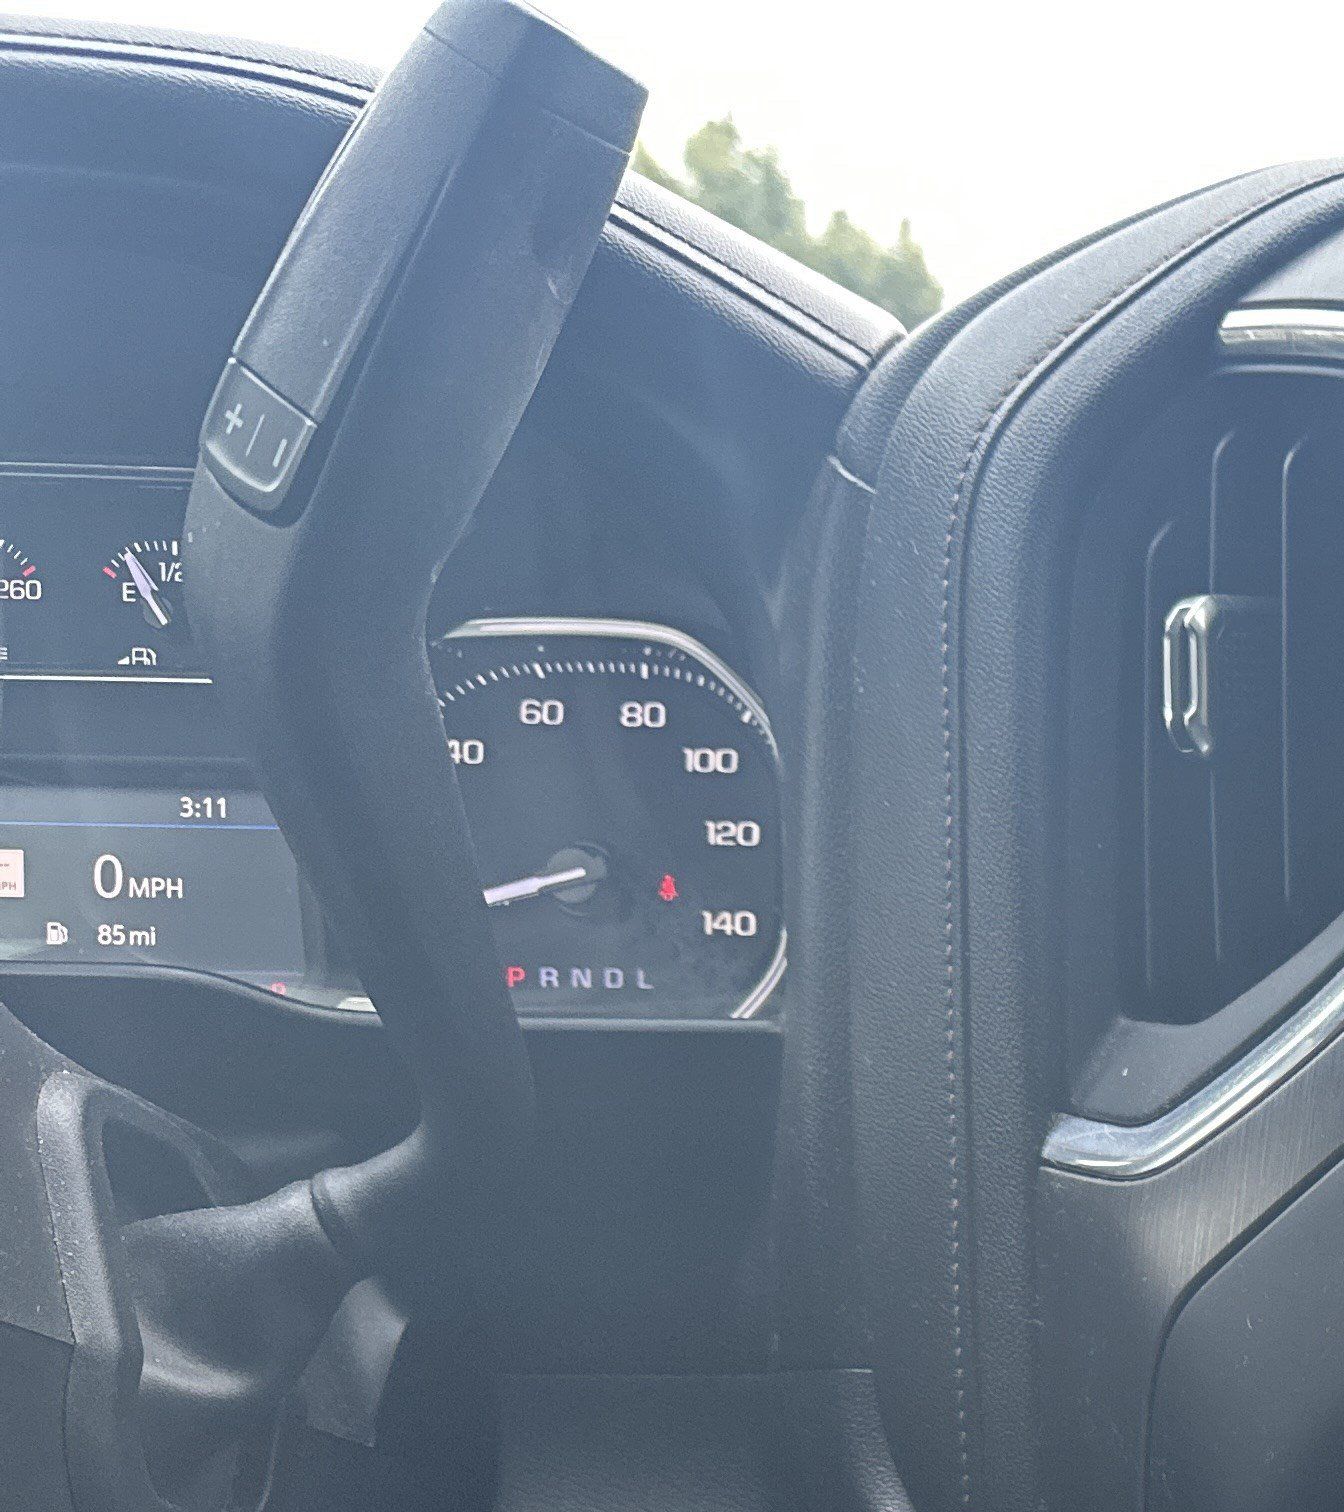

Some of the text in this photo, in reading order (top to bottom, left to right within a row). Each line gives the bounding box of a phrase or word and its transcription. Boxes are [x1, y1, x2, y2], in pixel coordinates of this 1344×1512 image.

[0, 579, 43, 601] 260
[121, 581, 137, 603] E
[519, 698, 565, 726] 60
[619, 701, 667, 728] 80
[682, 746, 739, 774] 100
[179, 796, 227, 819] 3:11
[704, 820, 761, 848] 120
[0, 880, 18, 892] PH
[93, 854, 184, 899] 0 MPH
[97, 924, 157, 946] 85 mi
[701, 910, 758, 938] 140
[505, 965, 526, 988] P
[538, 966, 560, 989] R
[571, 967, 592, 989] N
[636, 969, 655, 991] L
